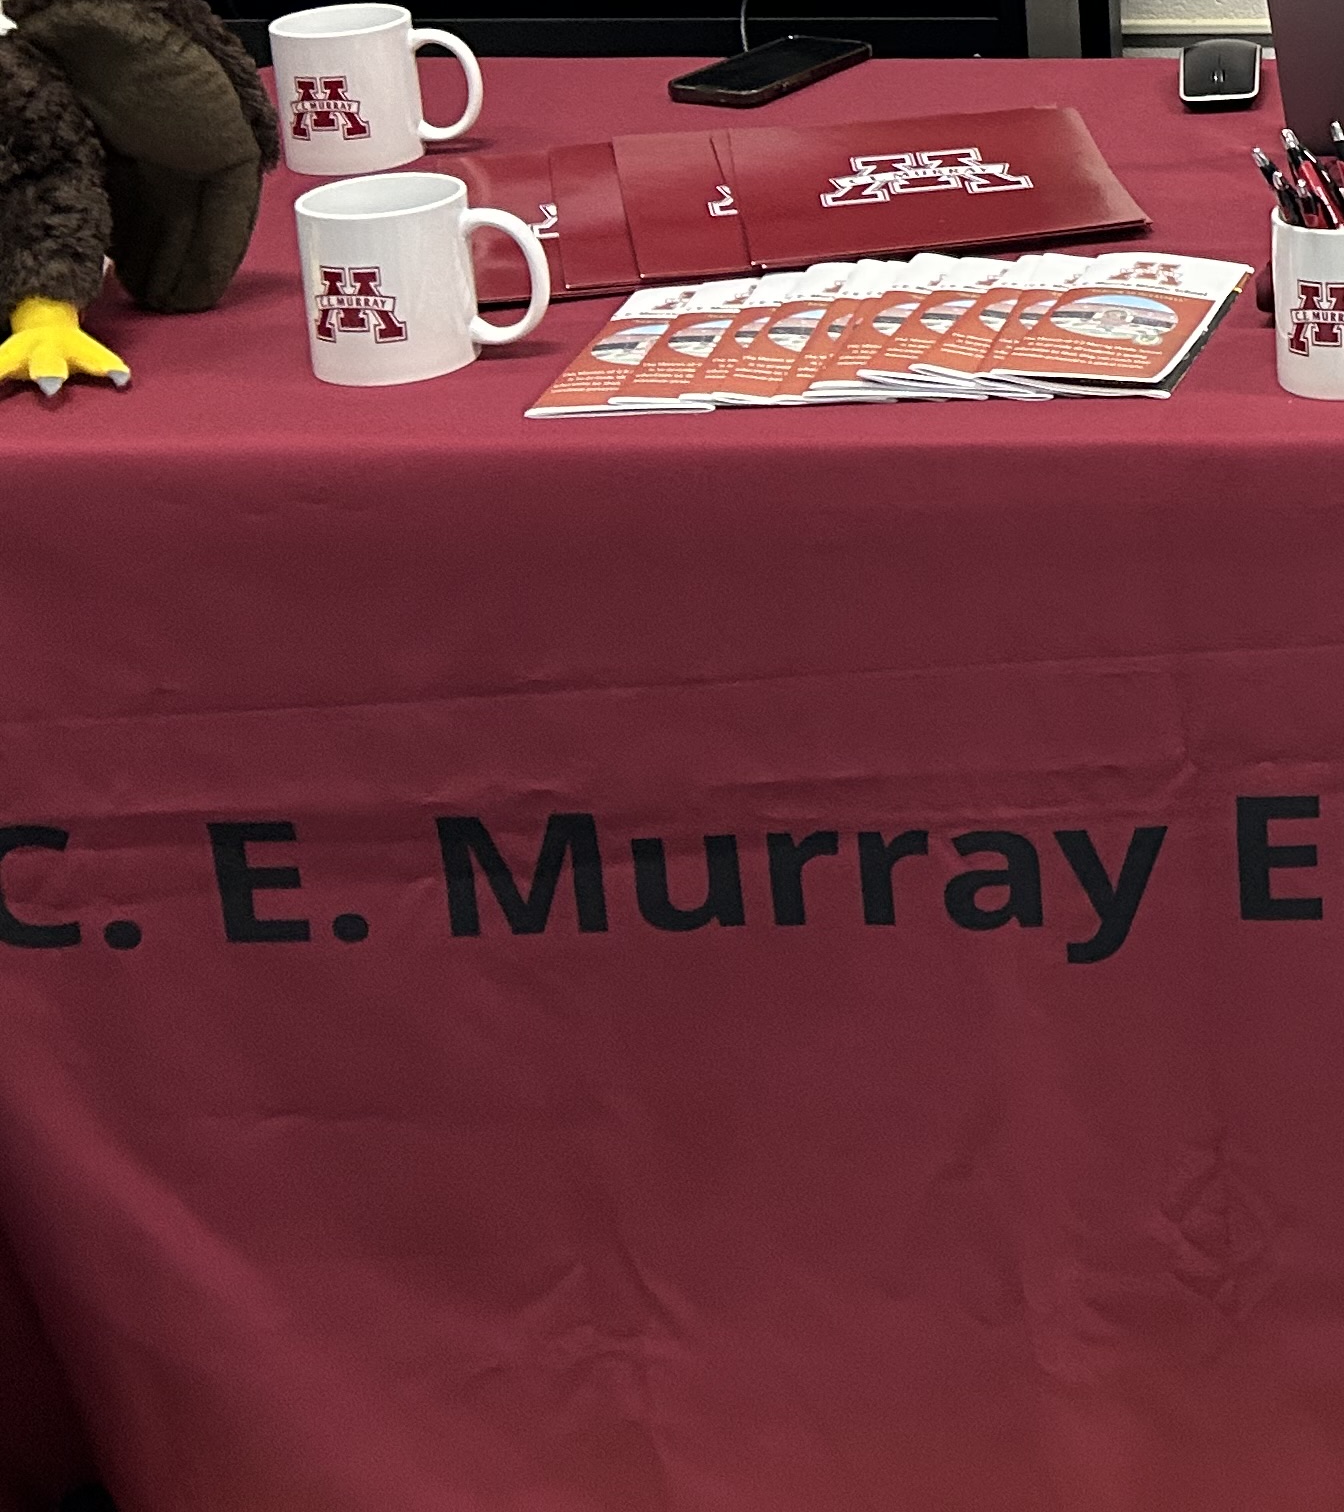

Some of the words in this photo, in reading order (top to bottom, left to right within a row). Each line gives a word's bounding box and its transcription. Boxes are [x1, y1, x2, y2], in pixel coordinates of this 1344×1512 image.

[337, 297, 386, 309] MURRAY
[0, 823, 144, 951] C.
[207, 819, 371, 944] E.
[435, 812, 1170, 965] Murray
